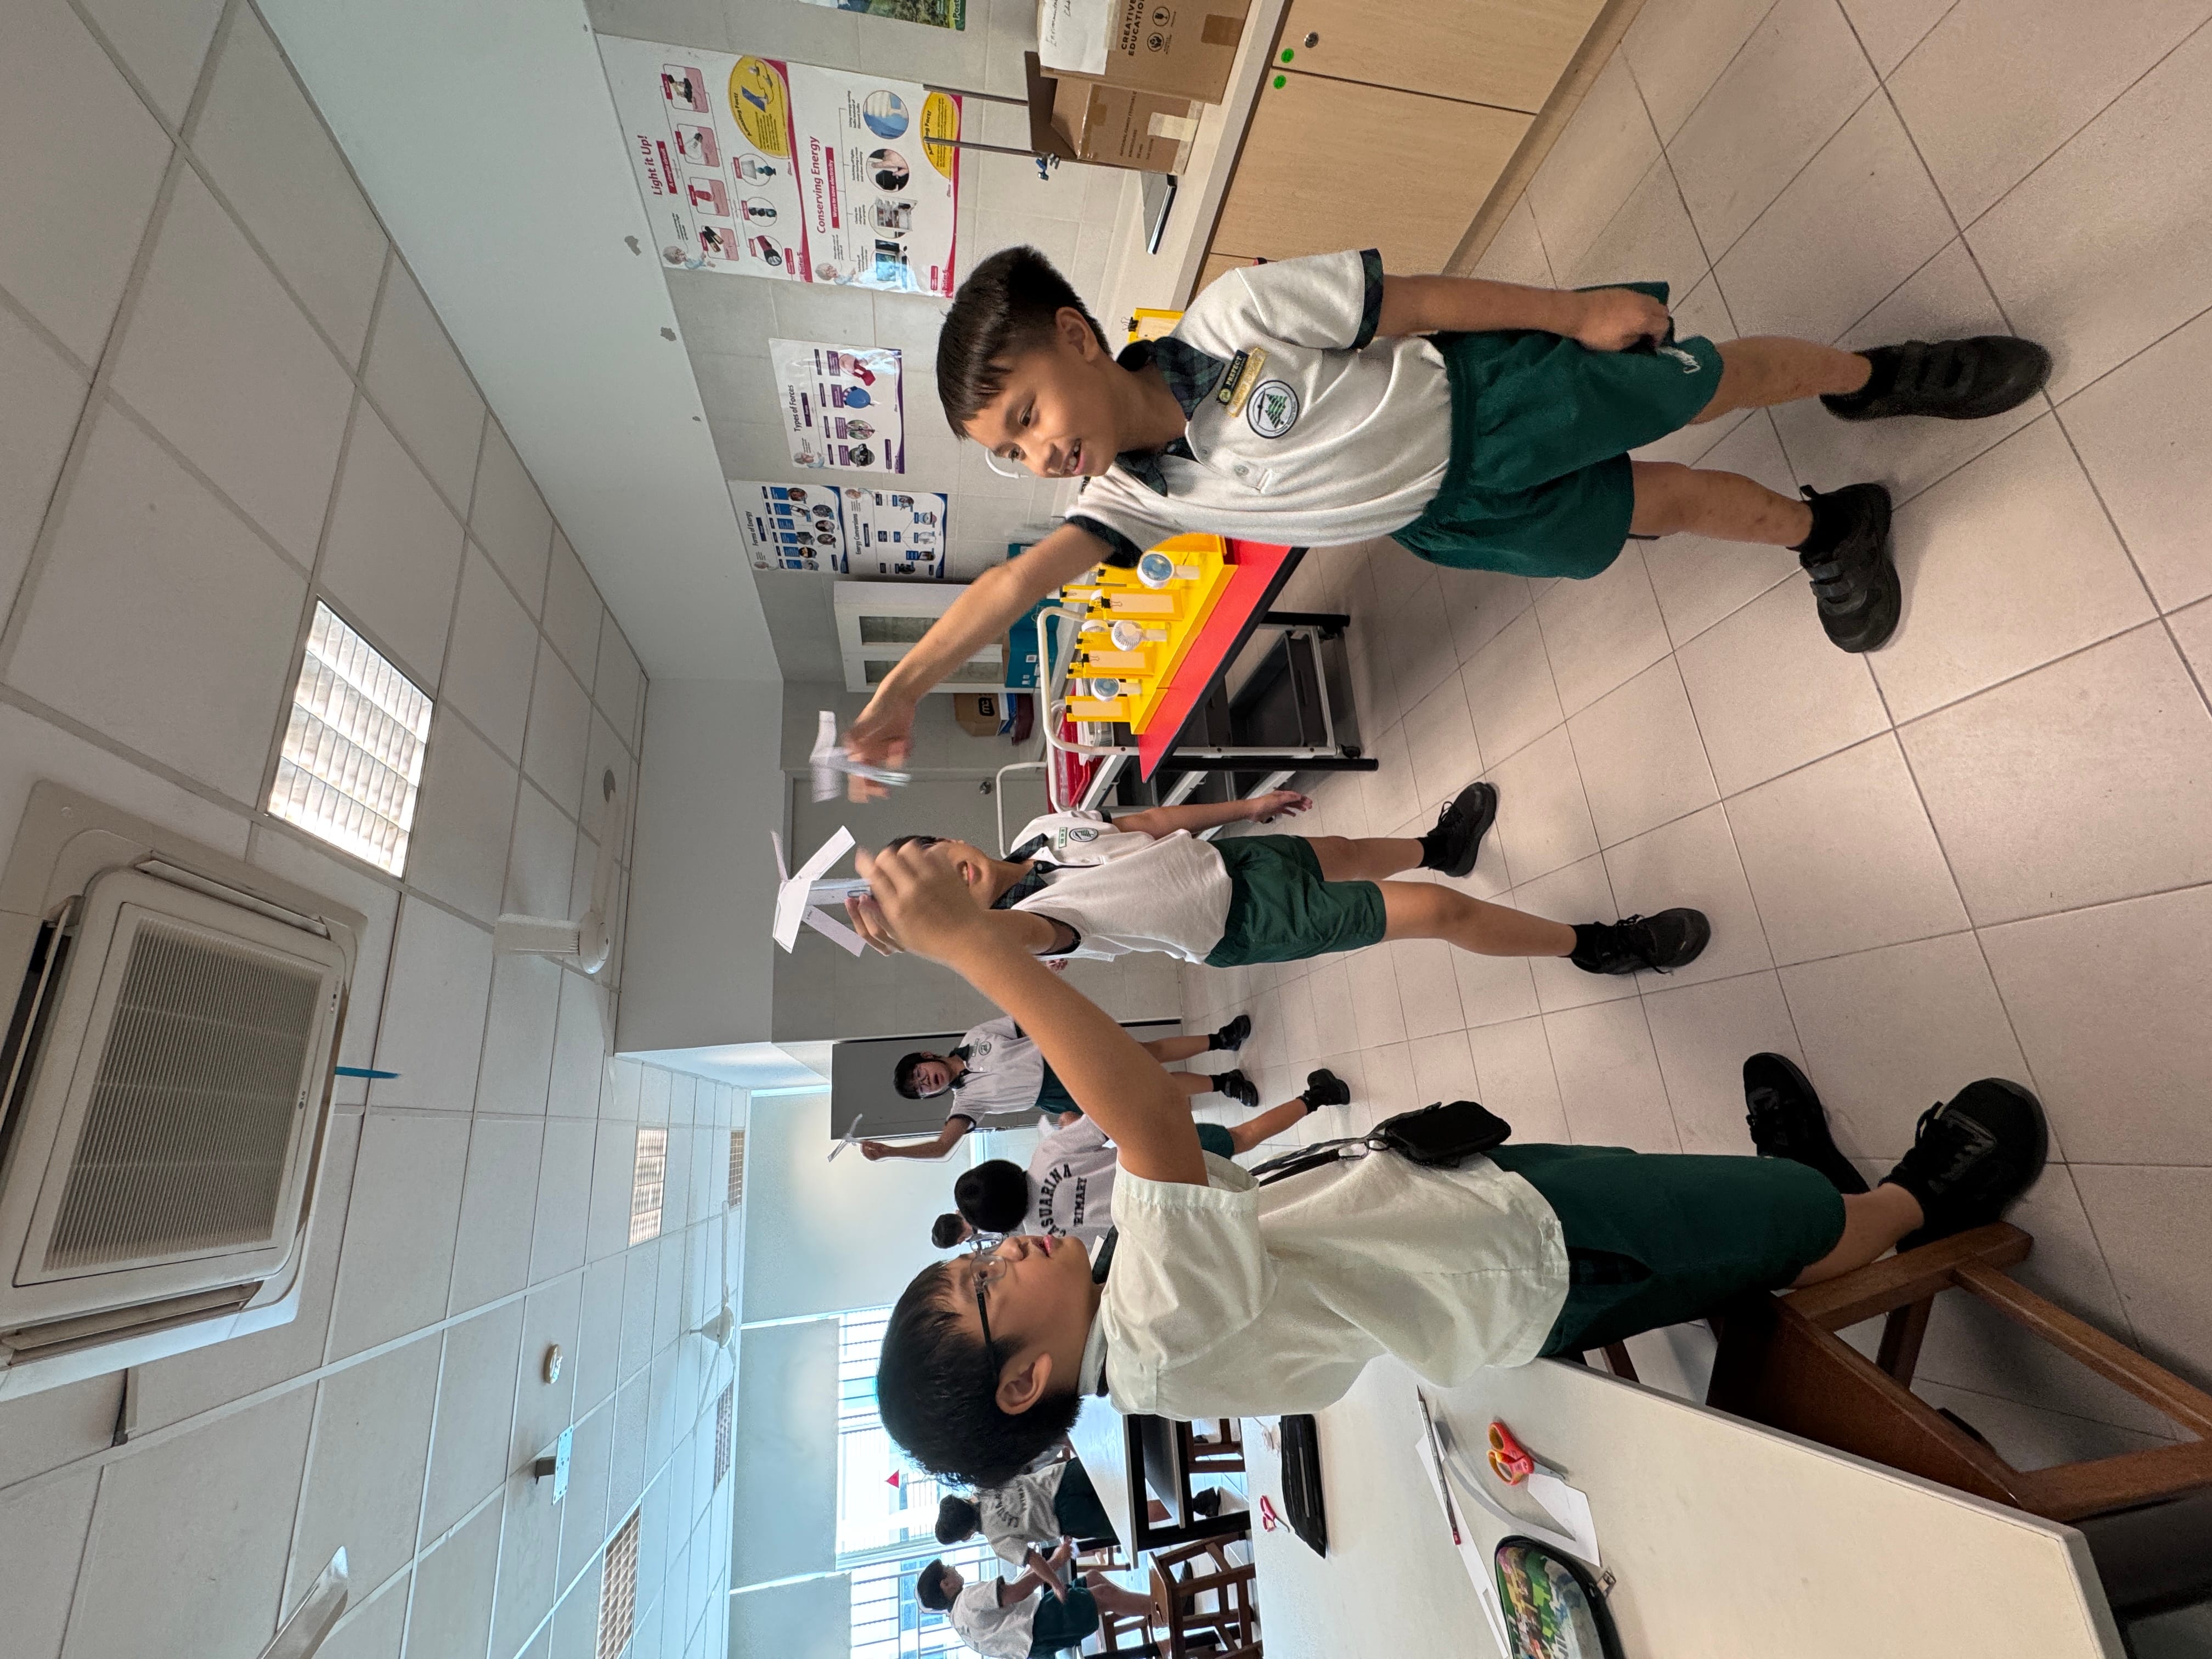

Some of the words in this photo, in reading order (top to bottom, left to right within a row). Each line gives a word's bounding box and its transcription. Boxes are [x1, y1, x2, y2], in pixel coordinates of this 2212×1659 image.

[1121, 0, 1136, 50] CREATIVE
[1128, 0, 1145, 57] EDUCATIO
[737, 109, 752, 137] Amazing
[637, 134, 652, 155] Up!
[810, 136, 820, 176] Energy
[645, 157, 654, 166] it
[648, 168, 663, 196] Light
[812, 178, 826, 234] Conserving
[1225, 355, 1243, 386] PREFECT
[787, 385, 797, 406] Forces
[793, 414, 803, 432] Types
[745, 510, 754, 527] Energy
[852, 514, 860, 540] Conversions
[750, 533, 759, 546] Forms
[301, 1091, 306, 1100] LG
